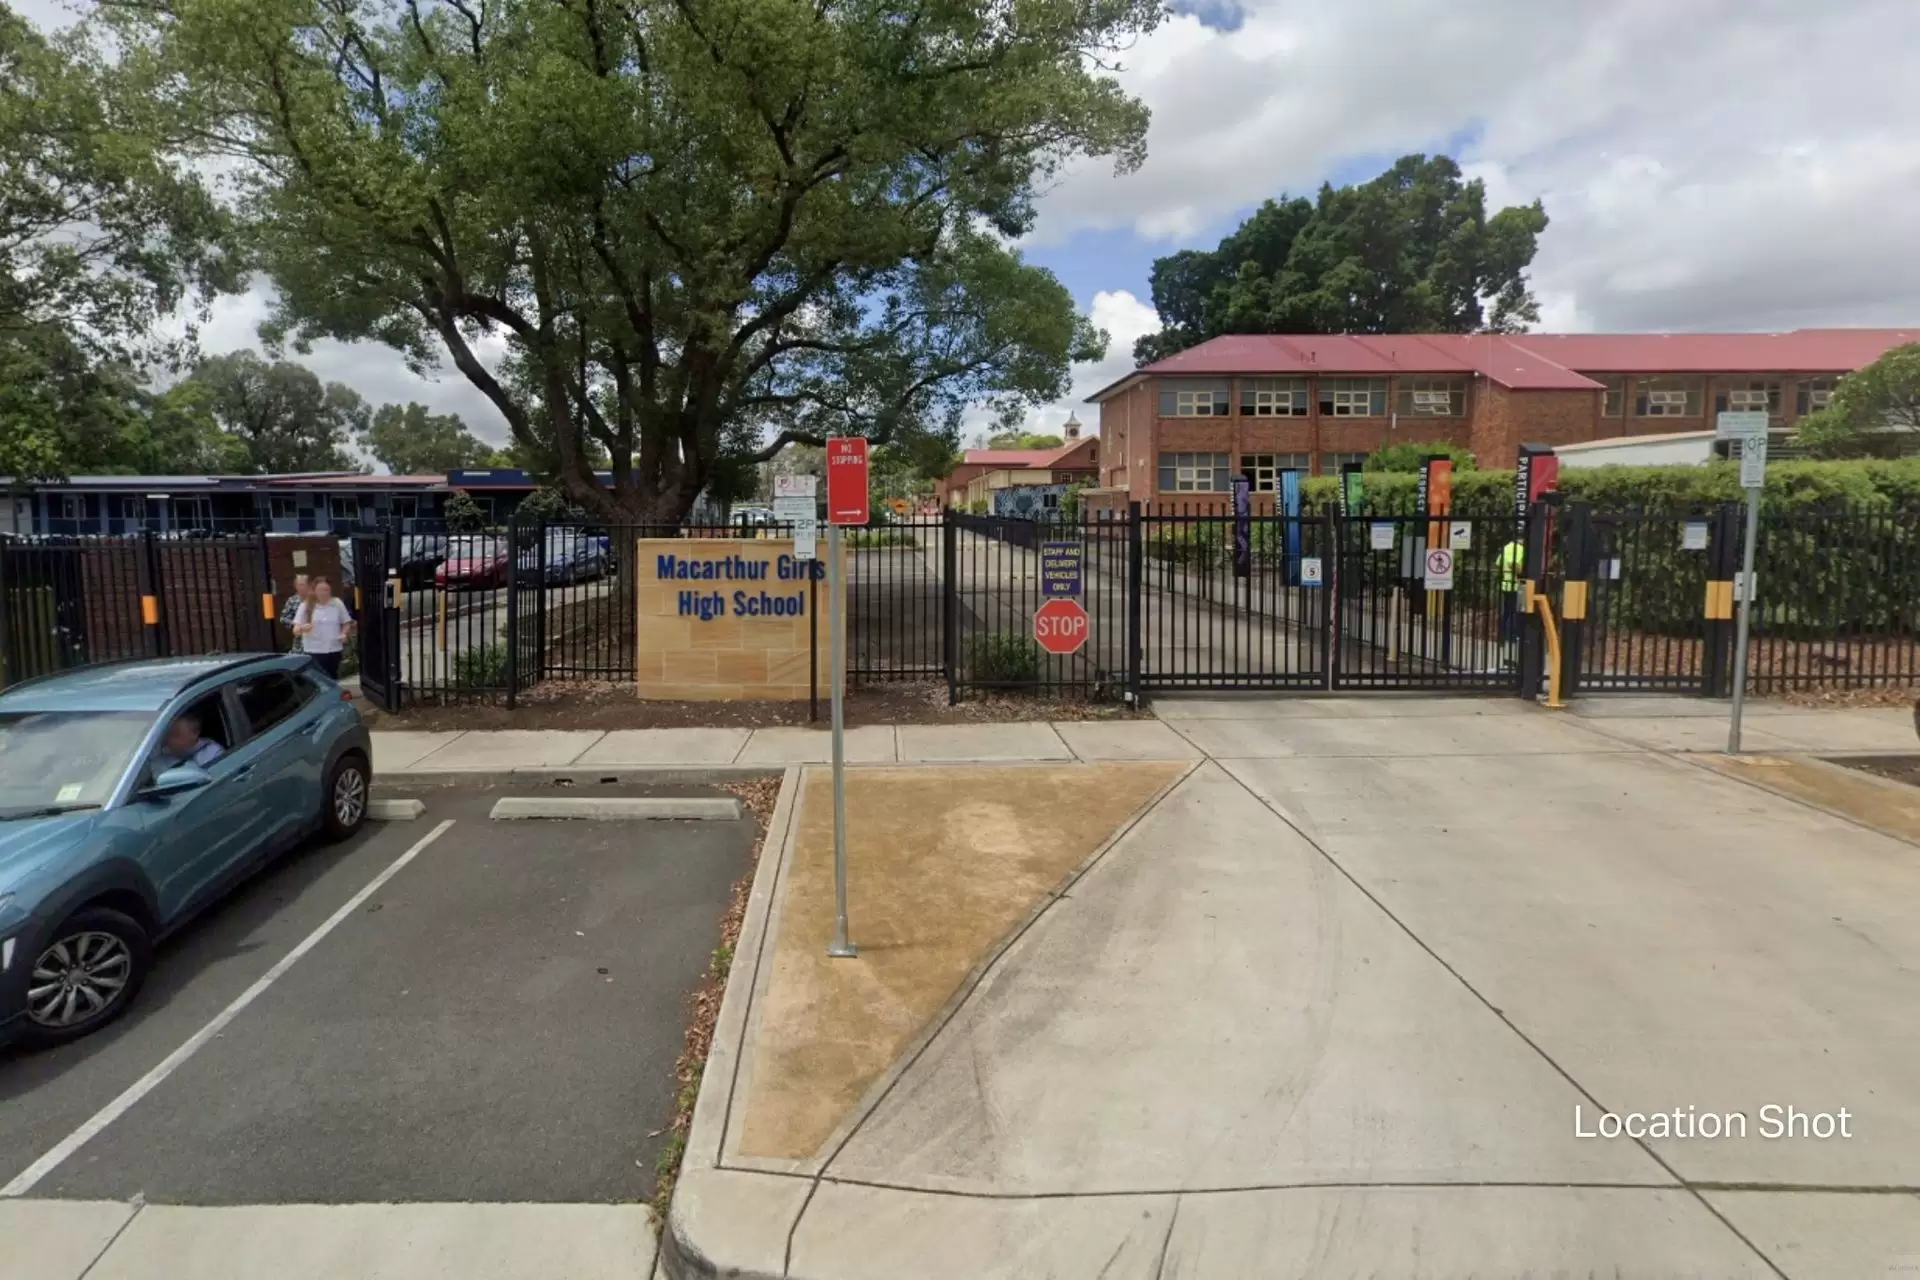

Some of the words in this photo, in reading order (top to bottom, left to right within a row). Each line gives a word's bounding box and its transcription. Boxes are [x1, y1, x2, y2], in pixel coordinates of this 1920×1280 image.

[841, 443, 852, 454] NO
[831, 455, 863, 465] STOPPING
[1417, 467, 1428, 512] RESPECT
[798, 519, 814, 530] 2P
[1044, 548, 1064, 556] STAFF
[1065, 548, 1081, 556] AND
[657, 554, 770, 580] Macarthur
[1045, 559, 1078, 568] DELIVERY
[1045, 571, 1078, 580] VEHICLES
[1309, 567, 1316, 576] 5
[1052, 582, 1071, 592] ONLY
[678, 590, 725, 621] High
[733, 590, 804, 616] School
[1038, 615, 1085, 637] STOP
